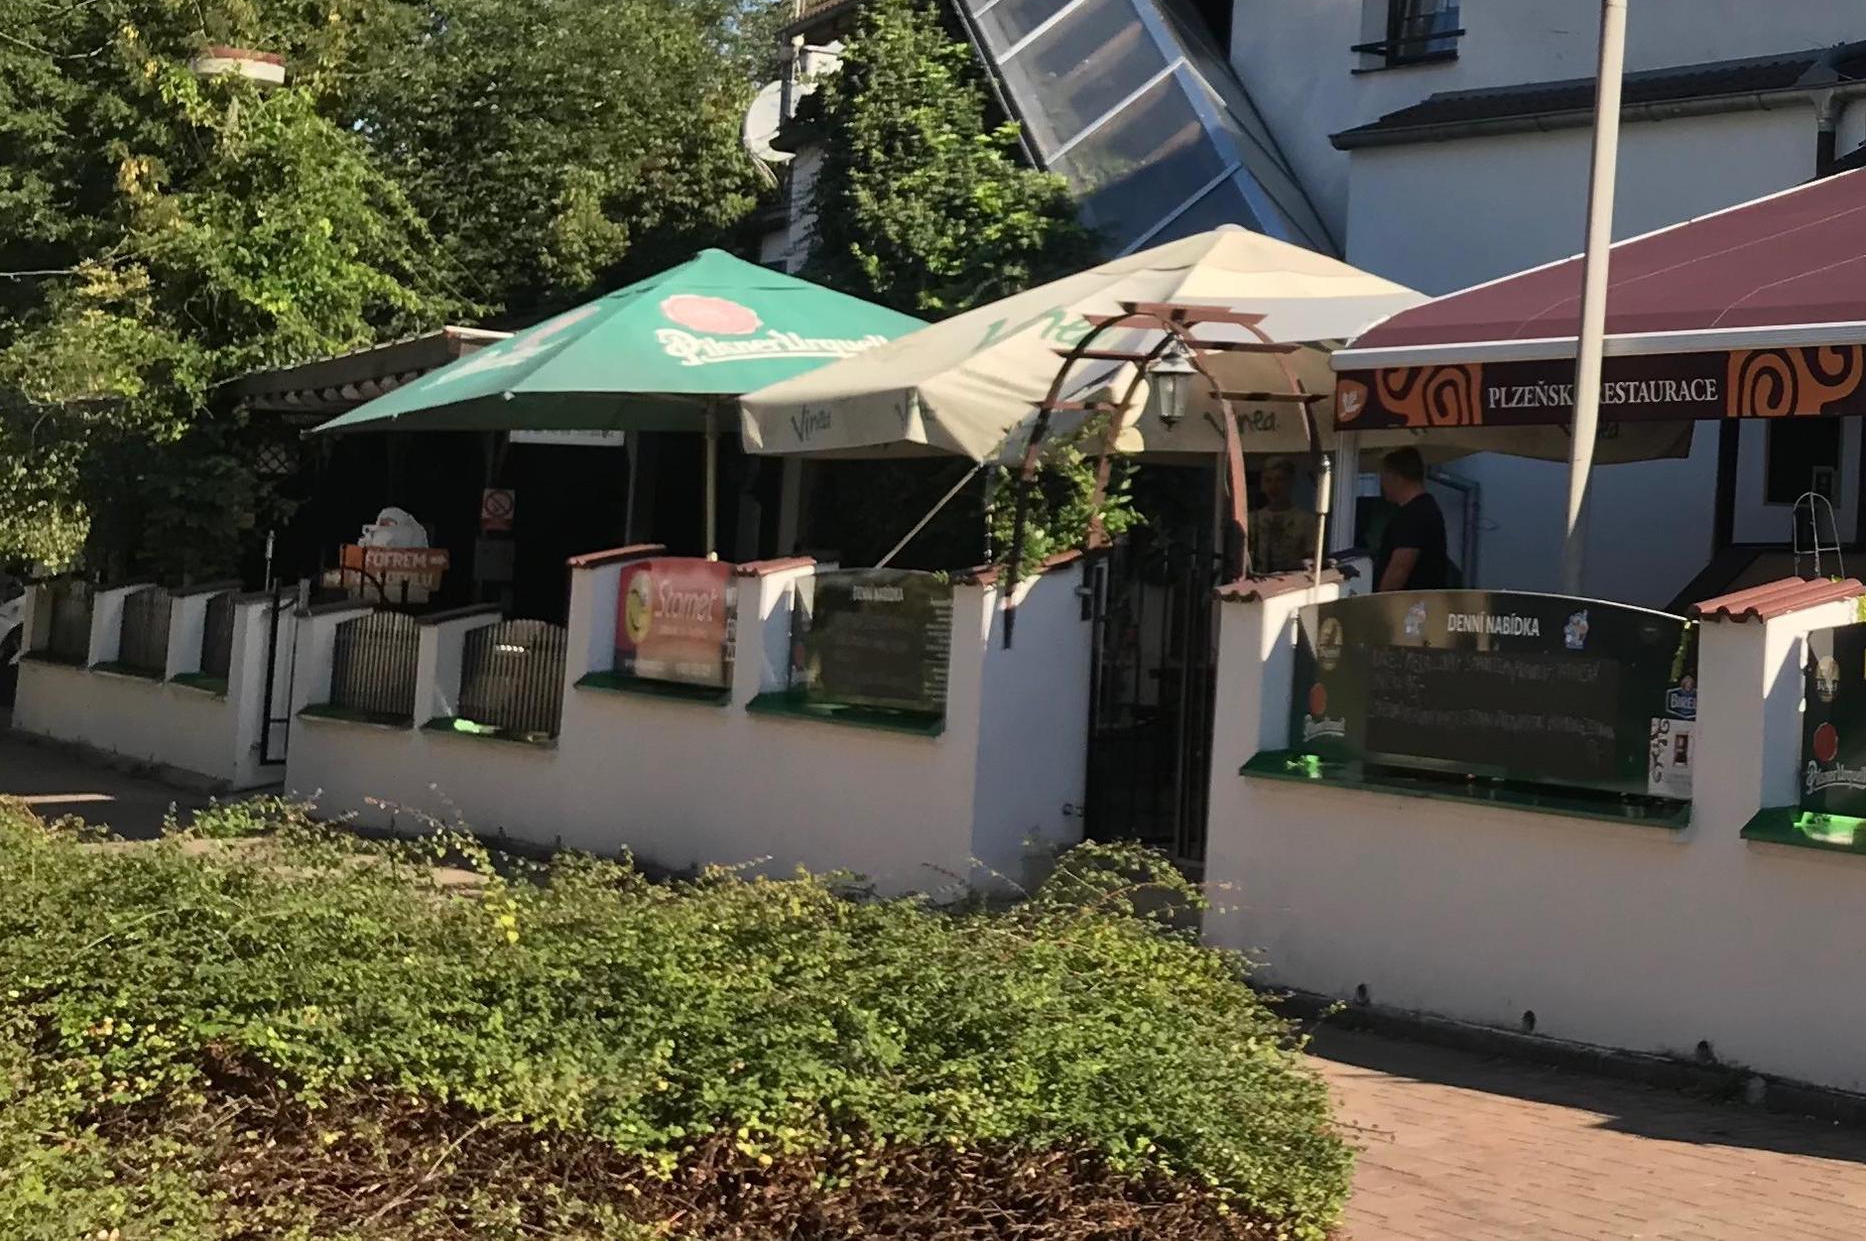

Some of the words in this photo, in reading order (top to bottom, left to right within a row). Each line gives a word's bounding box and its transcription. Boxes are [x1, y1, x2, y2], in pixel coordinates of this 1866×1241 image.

[655, 328, 774, 366] Pilsner
[1489, 381, 1574, 409] PLZEŇSK
[1204, 410, 1276, 438] Vnea
[1447, 611, 1486, 633] DENNÍ
[1486, 613, 1540, 636] NABÍDKA
